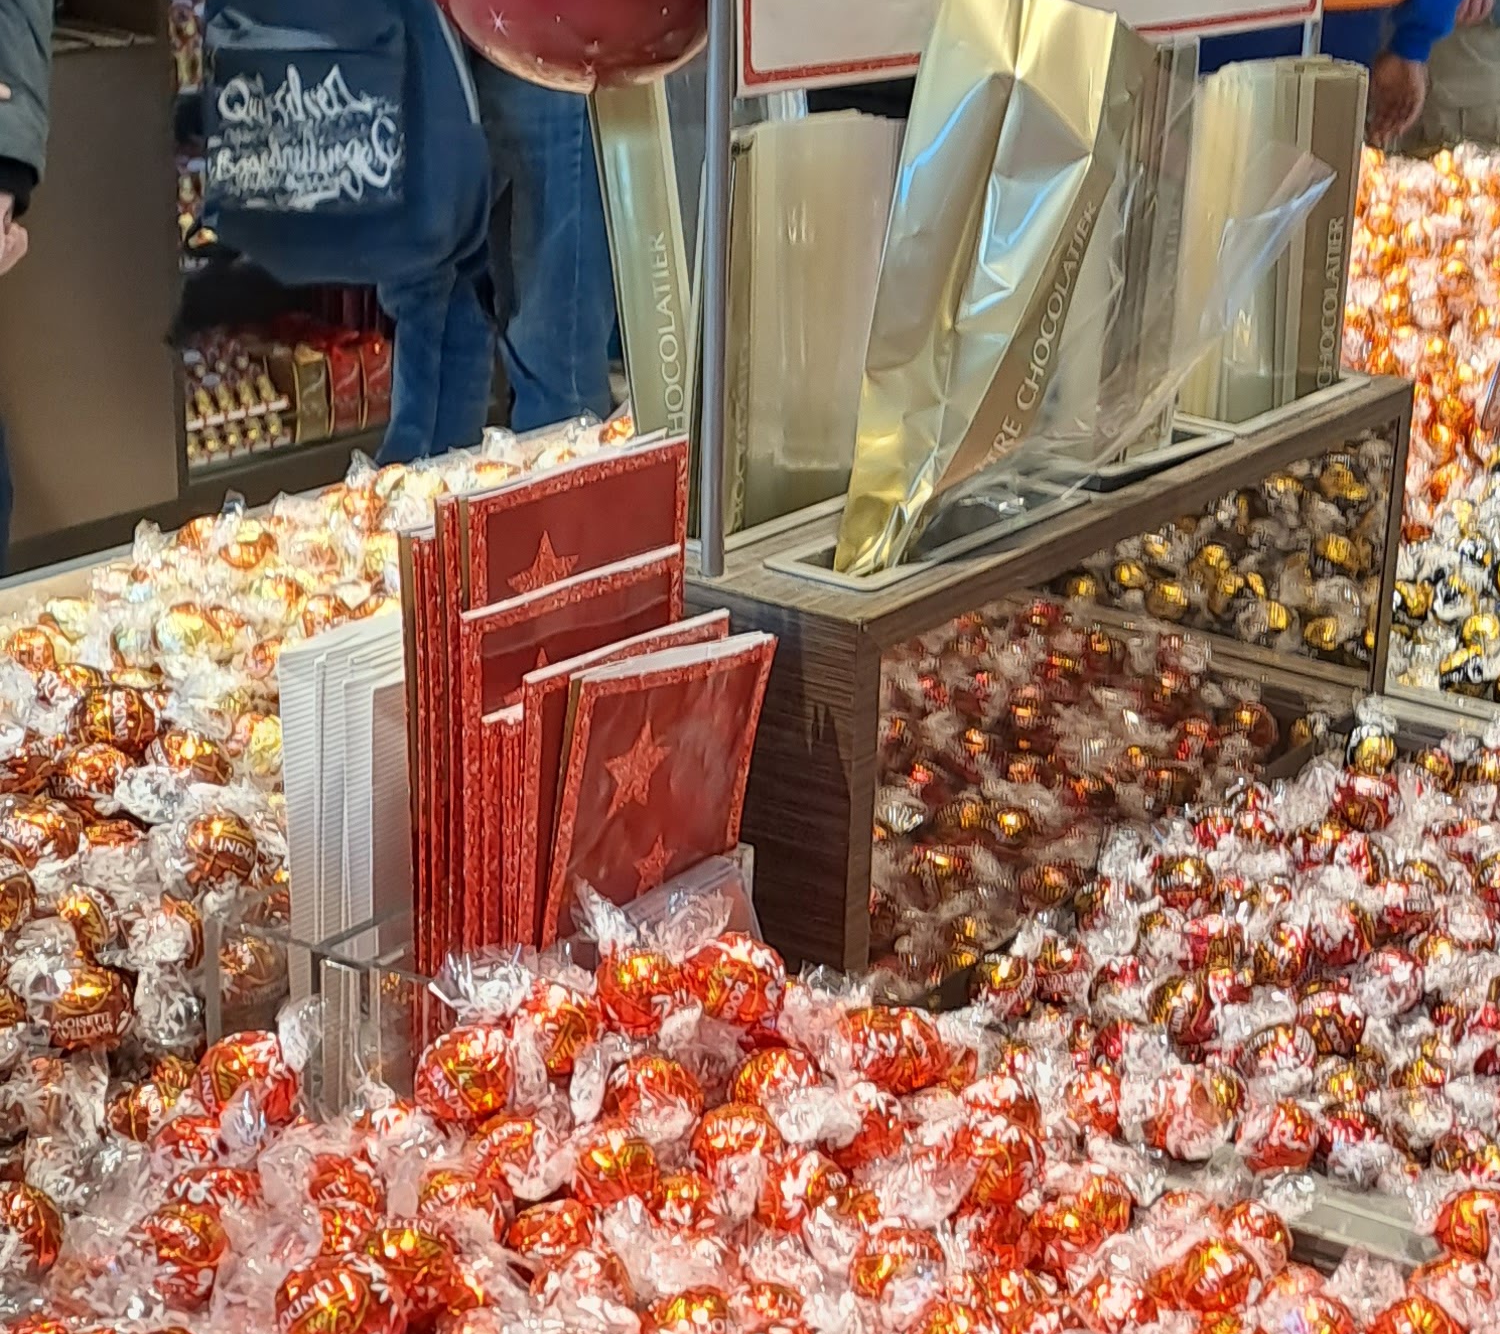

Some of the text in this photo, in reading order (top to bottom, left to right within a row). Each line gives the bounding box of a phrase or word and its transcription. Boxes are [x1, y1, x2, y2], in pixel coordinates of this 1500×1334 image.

[648, 230, 685, 437] HOCOLATIER
[1016, 200, 1097, 411] CHOCOLATIER
[1316, 214, 1345, 390] CHOCOLATIER
[210, 839, 256, 863] LINDO
[280, 1277, 336, 1333] LINDO
